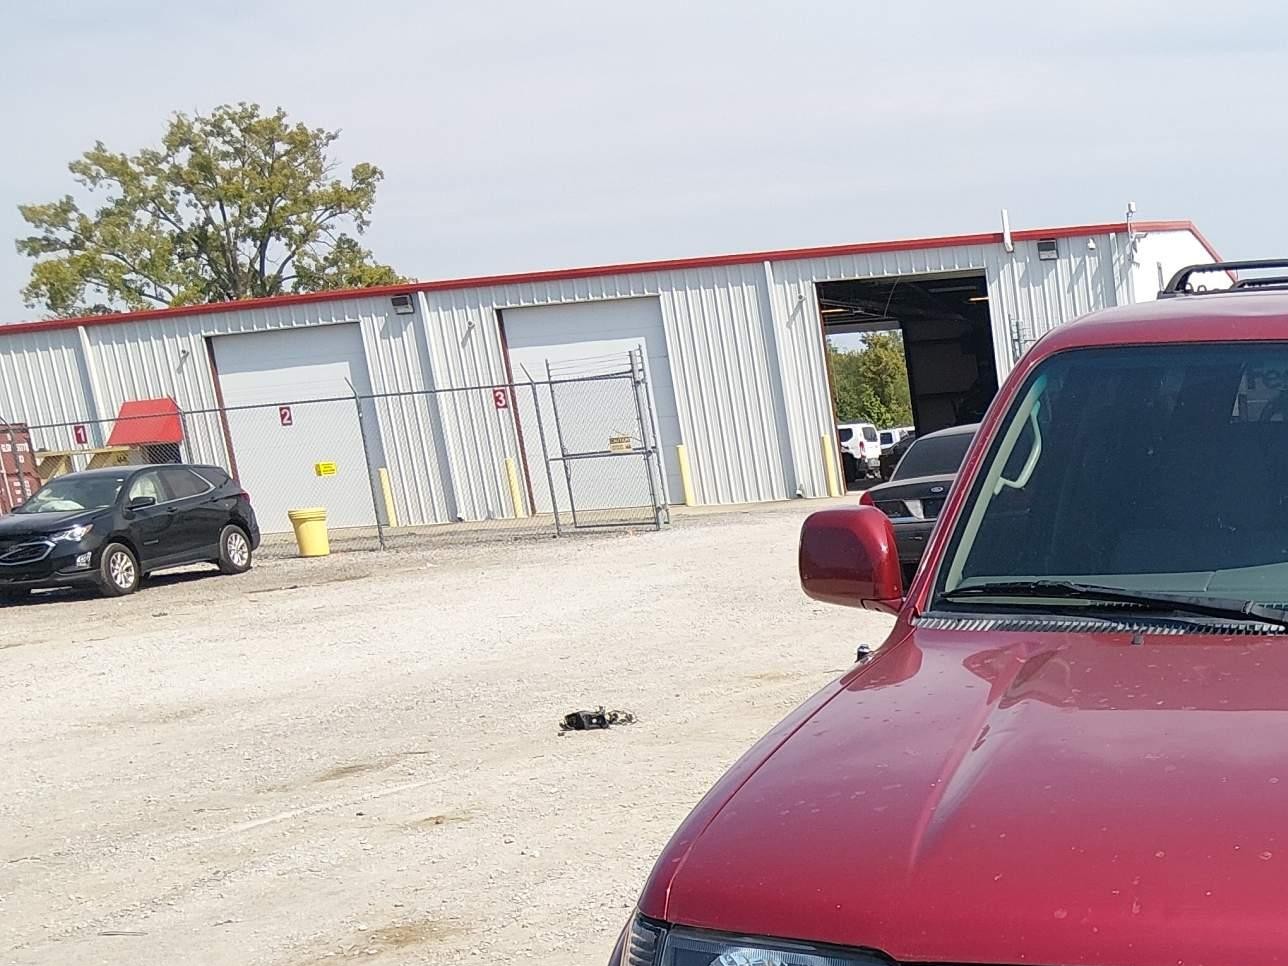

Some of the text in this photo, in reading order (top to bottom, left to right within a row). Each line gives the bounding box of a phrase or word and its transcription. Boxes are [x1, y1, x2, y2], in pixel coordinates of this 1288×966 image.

[495, 391, 506, 407] 3
[281, 409, 292, 424] 2
[76, 427, 86, 443] 1
